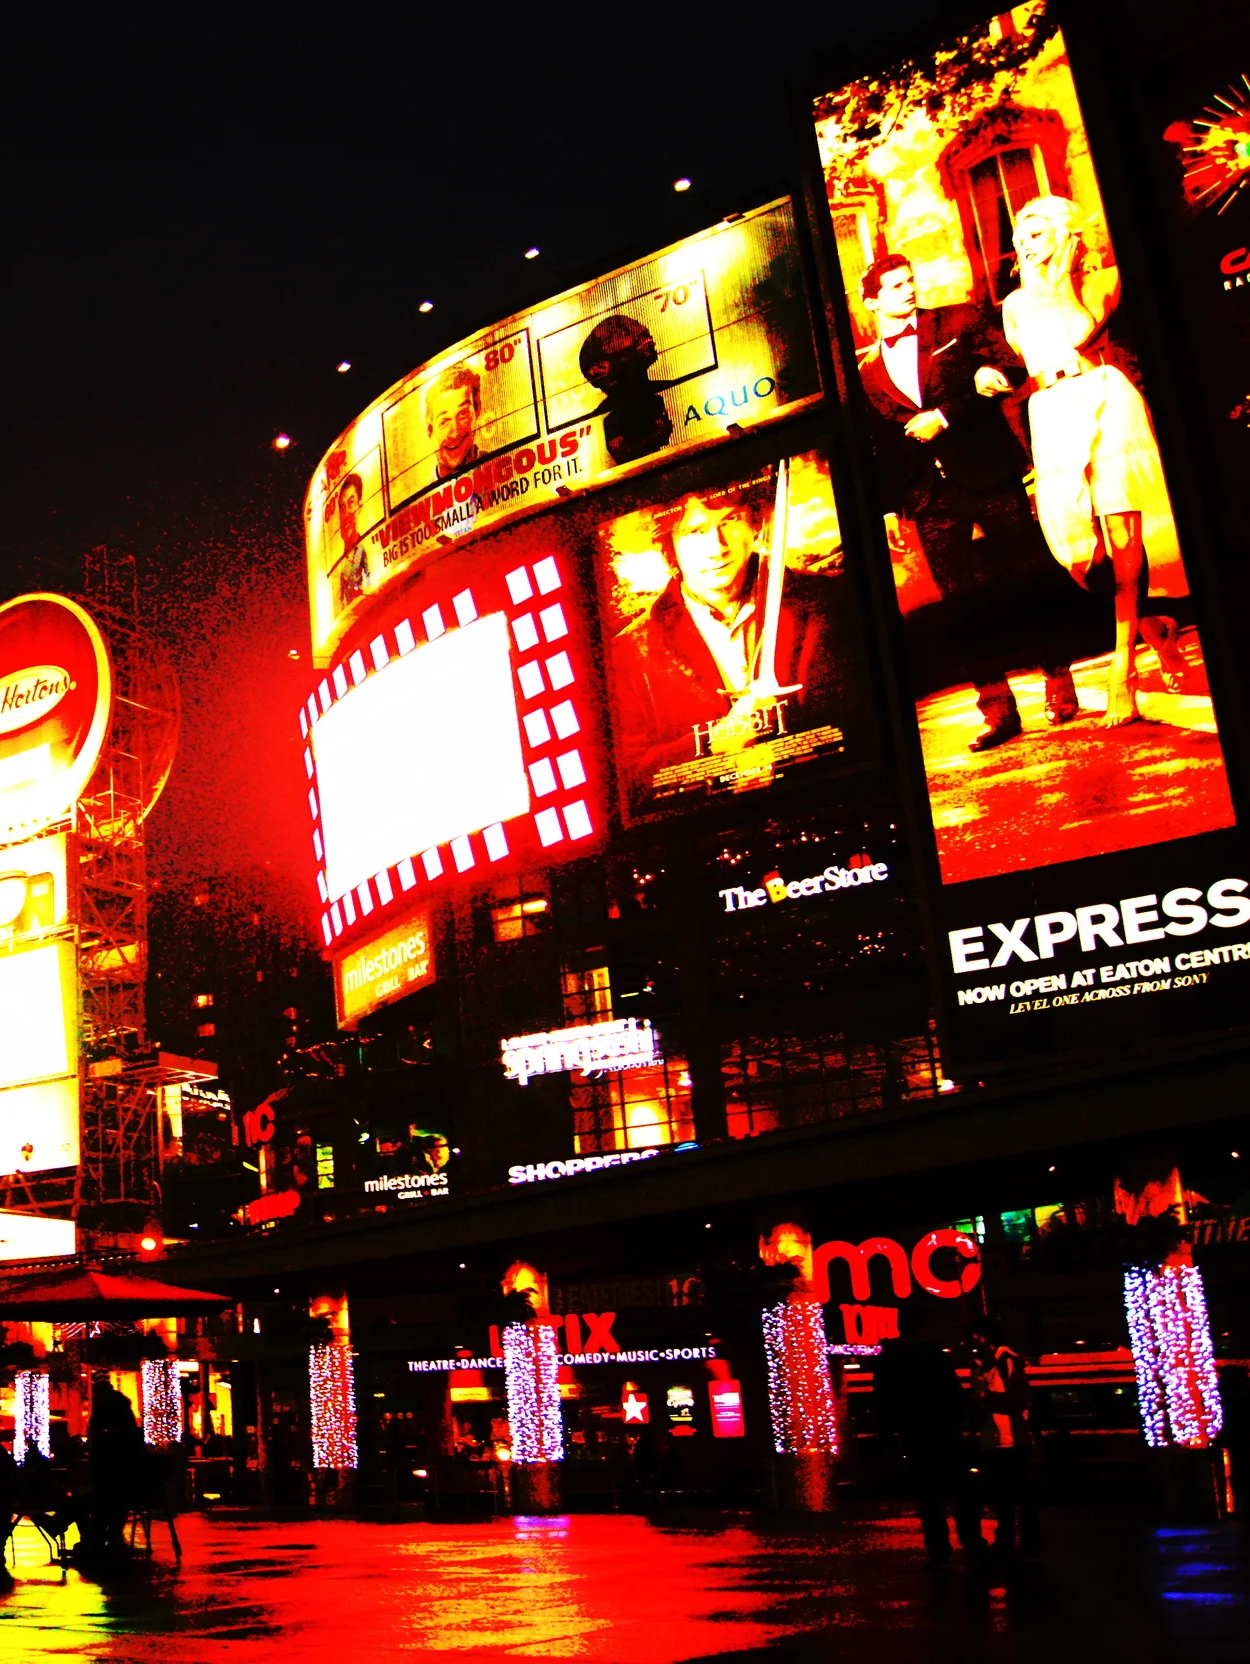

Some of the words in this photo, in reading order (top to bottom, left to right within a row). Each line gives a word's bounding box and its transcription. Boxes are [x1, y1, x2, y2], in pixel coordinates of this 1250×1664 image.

[484, 338, 521, 371] 80"
[383, 543, 398, 568] BIG
[400, 538, 410, 557] IS
[411, 523, 433, 549] TOO
[434, 504, 474, 534] SMALL
[476, 498, 486, 515] A
[485, 477, 530, 510] WORD
[534, 464, 563, 489] FOR
[567, 457, 583, 477] IT.
[0, 676, 69, 714] Hortons
[691, 700, 789, 757] HOBBIT
[719, 885, 768, 913] The
[766, 874, 825, 904] Beer
[823, 862, 889, 892] Store
[948, 878, 1250, 974] EXPRESS
[344, 931, 426, 994] milestones
[376, 975, 401, 998] GRILL
[408, 959, 429, 982] BAR
[957, 983, 1007, 1007] NOW
[1009, 973, 1068, 999] OPEN
[1071, 968, 1097, 989] AT
[1100, 956, 1172, 984] EATON
[1009, 998, 1051, 1015] LEVEL
[1052, 993, 1080, 1008] ONE
[1081, 984, 1131, 1003] ACROSS
[1133, 978, 1170, 996] FROM
[1173, 972, 1211, 988] SONY
[364, 1172, 449, 1193] milestones
[397, 1190, 423, 1200] GRILL
[430, 1187, 449, 1196] BAR
[407, 1360, 456, 1373] THEATRE
[461, 1357, 506, 1370] DANCE
[555, 1352, 610, 1366] COMEDY
[616, 1349, 659, 1363] MUSIC
[665, 1346, 717, 1360] SPORTS
